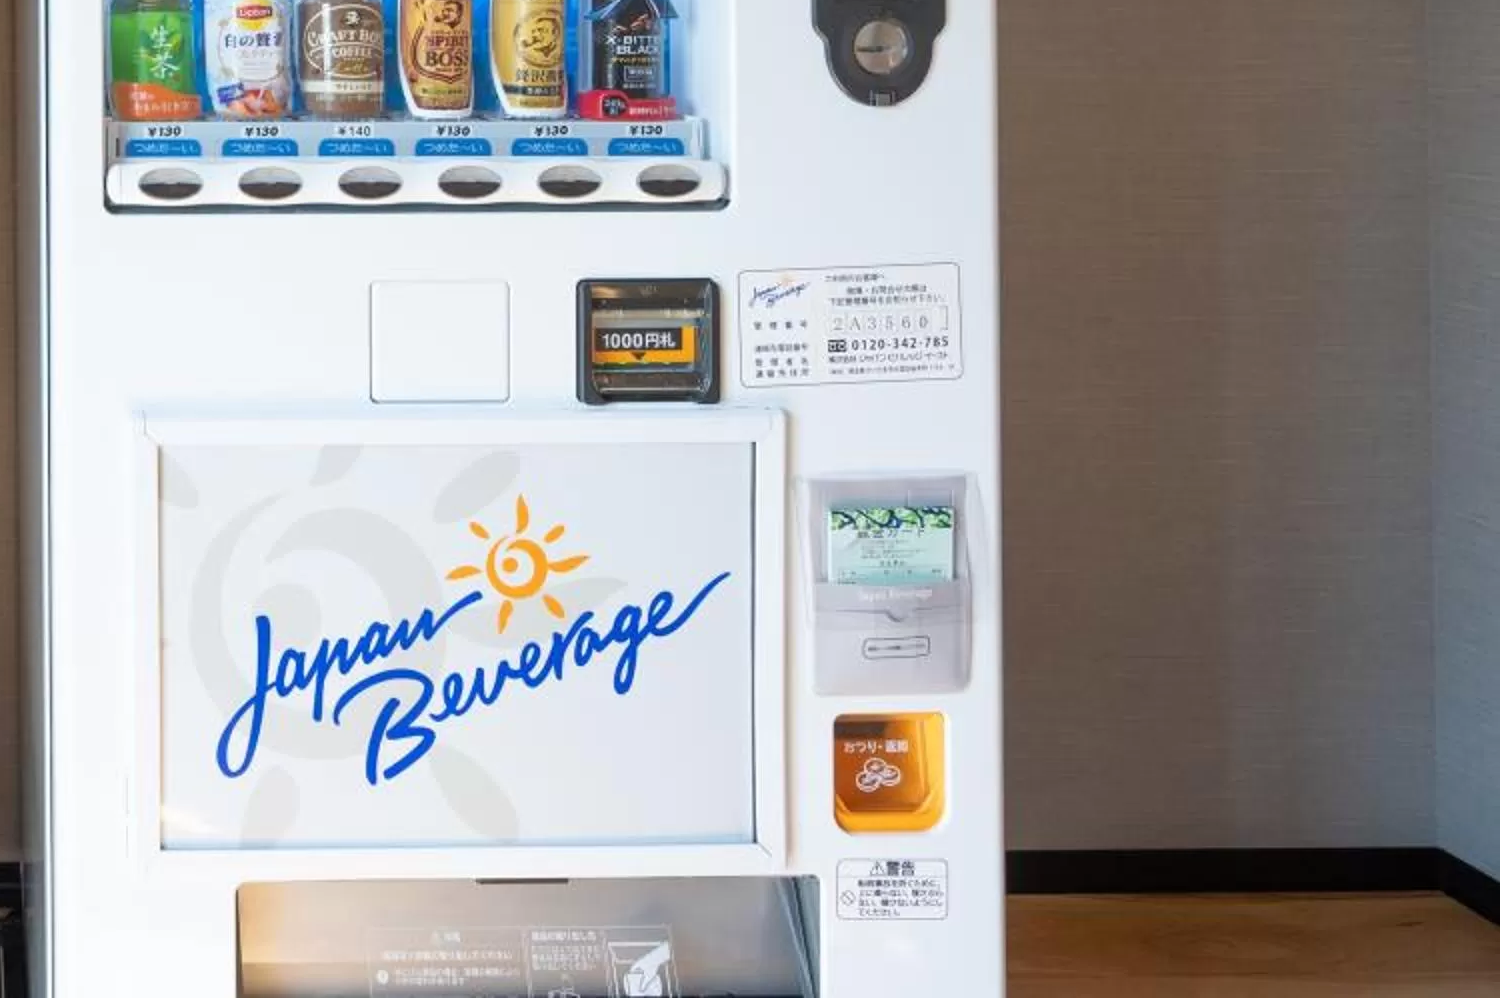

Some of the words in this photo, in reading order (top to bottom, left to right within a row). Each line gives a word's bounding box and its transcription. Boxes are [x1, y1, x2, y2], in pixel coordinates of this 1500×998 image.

[151, 24, 181, 79] 生茶
[148, 127, 181, 136] ¥130
[245, 127, 278, 136] ¥130
[338, 127, 371, 136] ¥140
[437, 127, 470, 136] ¥130
[534, 126, 568, 135] ¥130
[602, 333, 676, 348] 1000円札
[852, 336, 949, 351] 0120-342-785
[216, 591, 483, 778] Japan
[332, 572, 731, 786] Beverage
[887, 861, 915, 876] 警告
